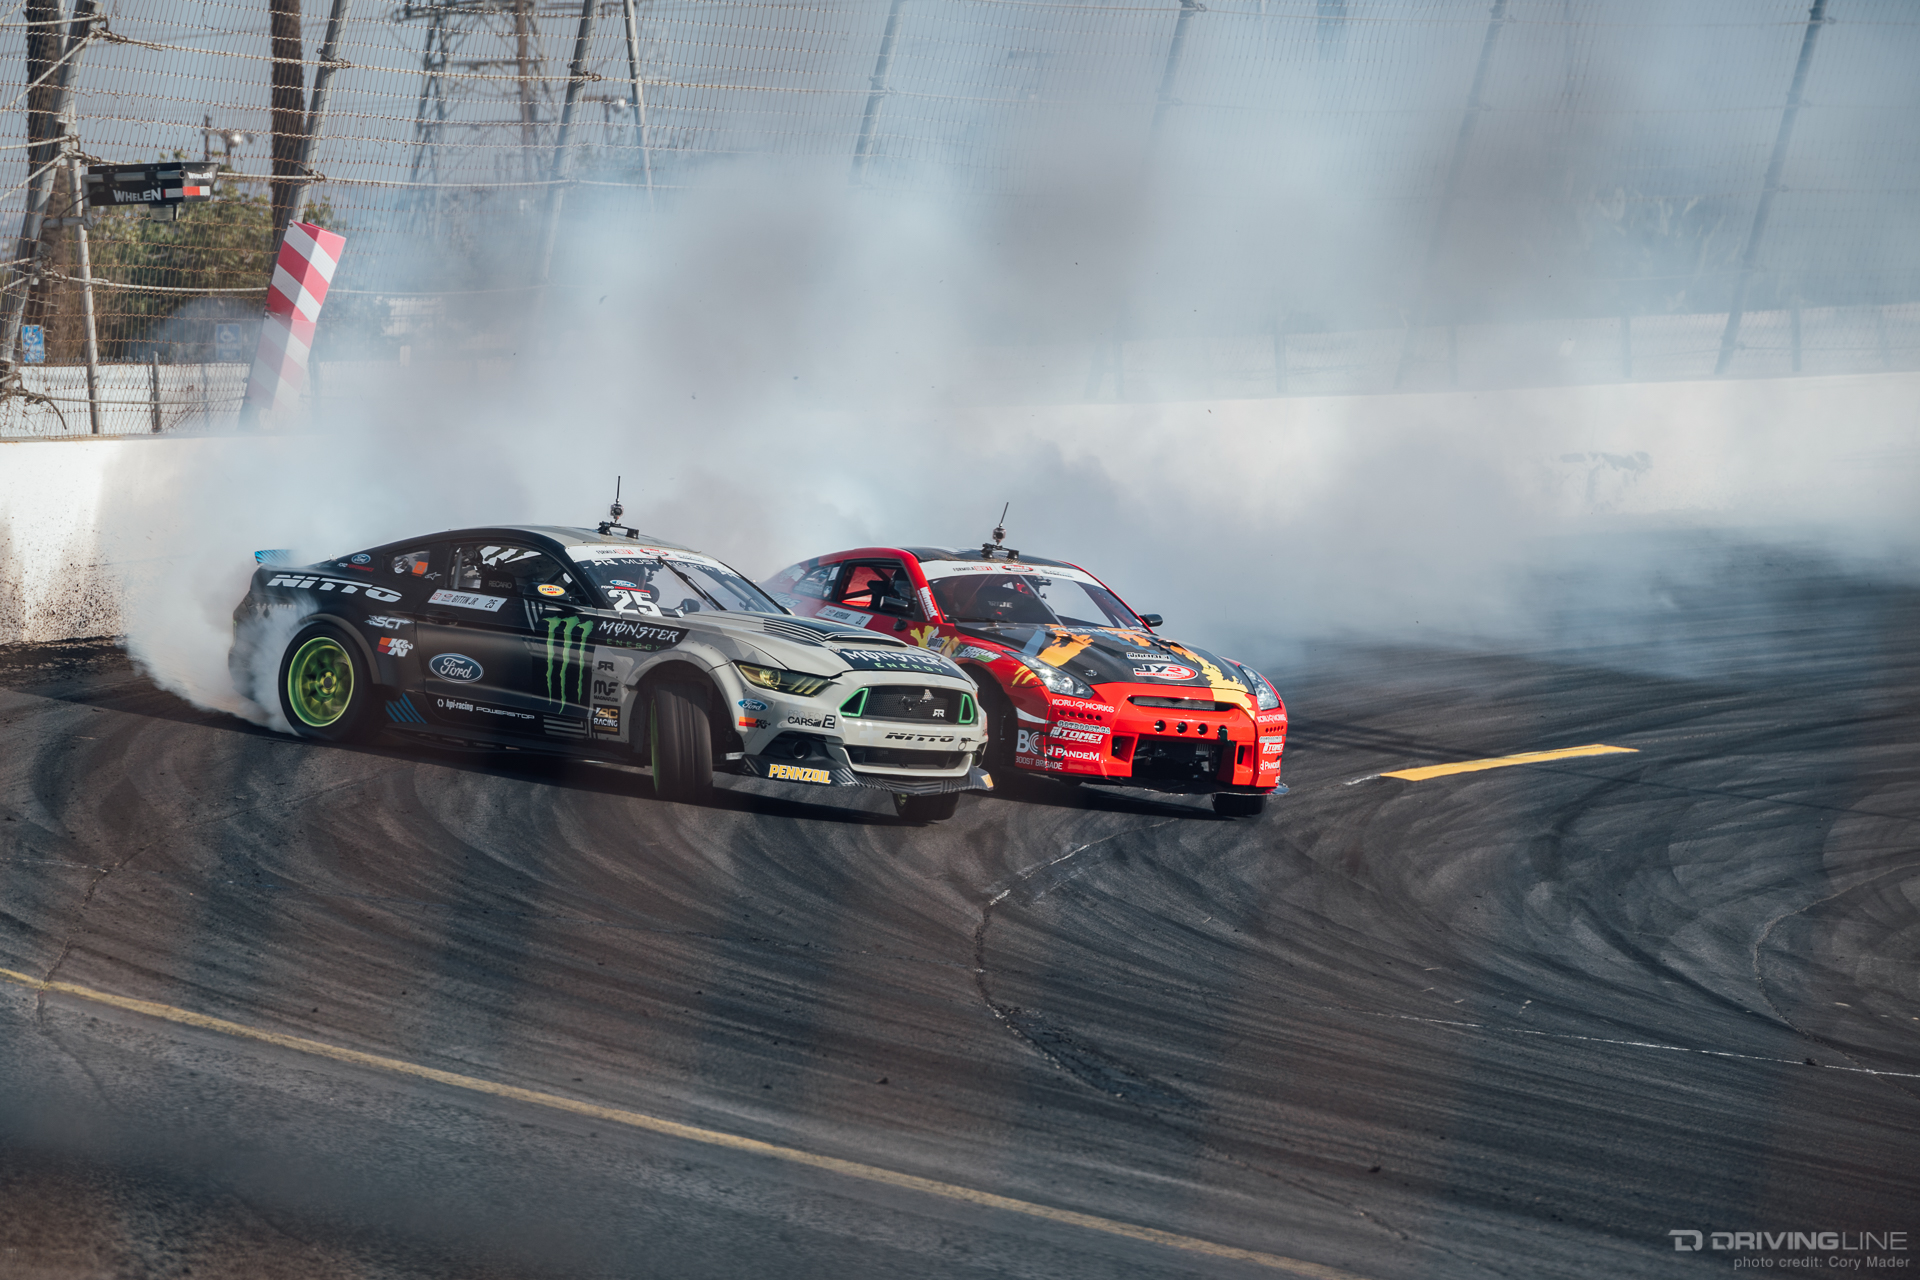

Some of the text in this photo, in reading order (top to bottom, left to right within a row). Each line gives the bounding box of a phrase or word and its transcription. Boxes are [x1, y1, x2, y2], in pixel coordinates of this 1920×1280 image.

[187, 171, 213, 179] WHELEN
[113, 187, 162, 202] WHELEN
[266, 574, 403, 603] NITTO
[488, 580, 513, 589] RECARO
[484, 598, 499, 609] 25
[607, 589, 663, 617] 25
[606, 638, 661, 651] ENERGY
[439, 656, 474, 679] Ford
[874, 662, 944, 674] ENERGY
[445, 699, 474, 712] hpi-racing
[593, 695, 619, 703] MAGNAFLOW
[1052, 699, 1115, 713] KORU WORKS
[476, 706, 535, 720] POWERSTOP
[593, 717, 619, 728] RACING
[787, 715, 836, 729] CARS 2
[884, 732, 955, 743] NITTO
[1061, 729, 1104, 742] TOMEI
[1055, 747, 1100, 761] PANDEM
[1035, 759, 1064, 771] BRIGADE
[768, 763, 832, 784] PENNZOIL
